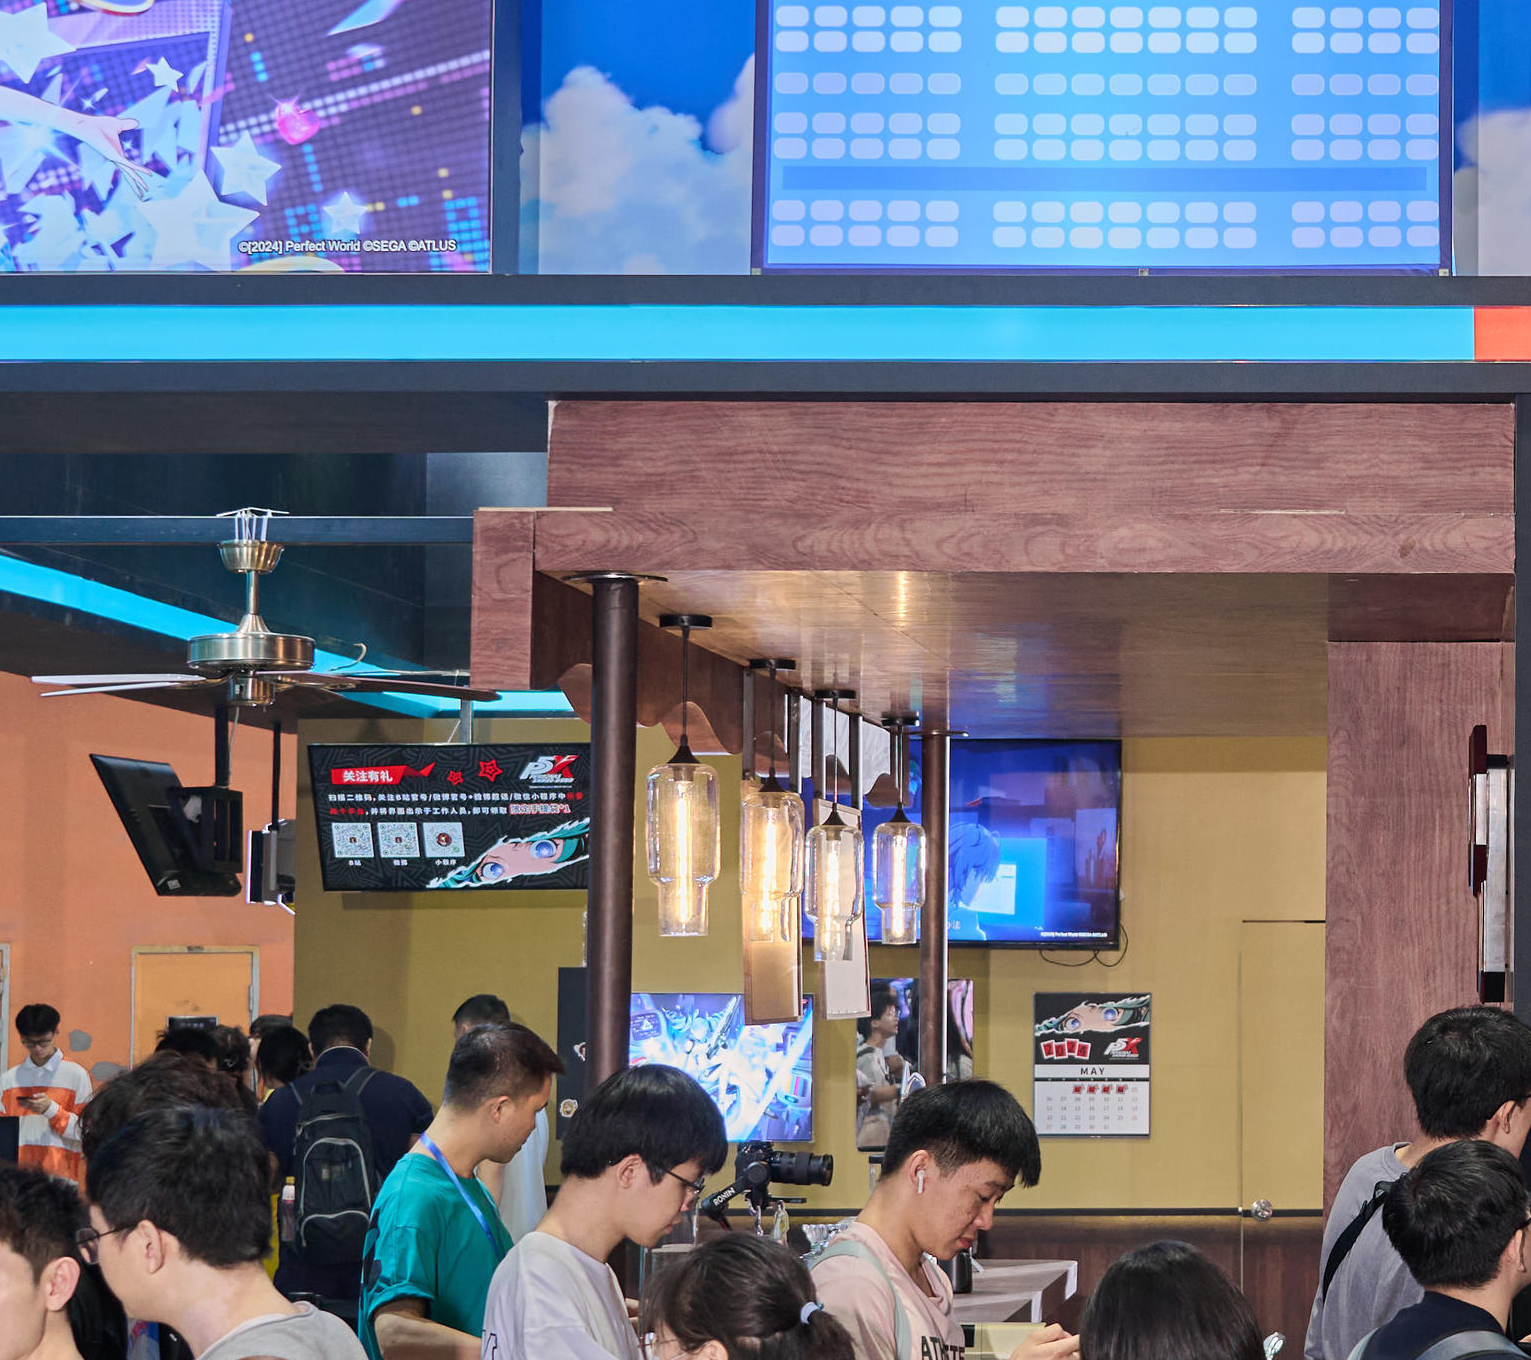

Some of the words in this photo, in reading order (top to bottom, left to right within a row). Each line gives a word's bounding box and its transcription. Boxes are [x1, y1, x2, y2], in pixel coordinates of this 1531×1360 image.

[285, 240, 326, 253] Perfect
[328, 240, 361, 253] World
[343, 769, 393, 783] 关注有礼
[1080, 1067, 1106, 1076] MAY
[712, 1187, 737, 1207] RONIN
